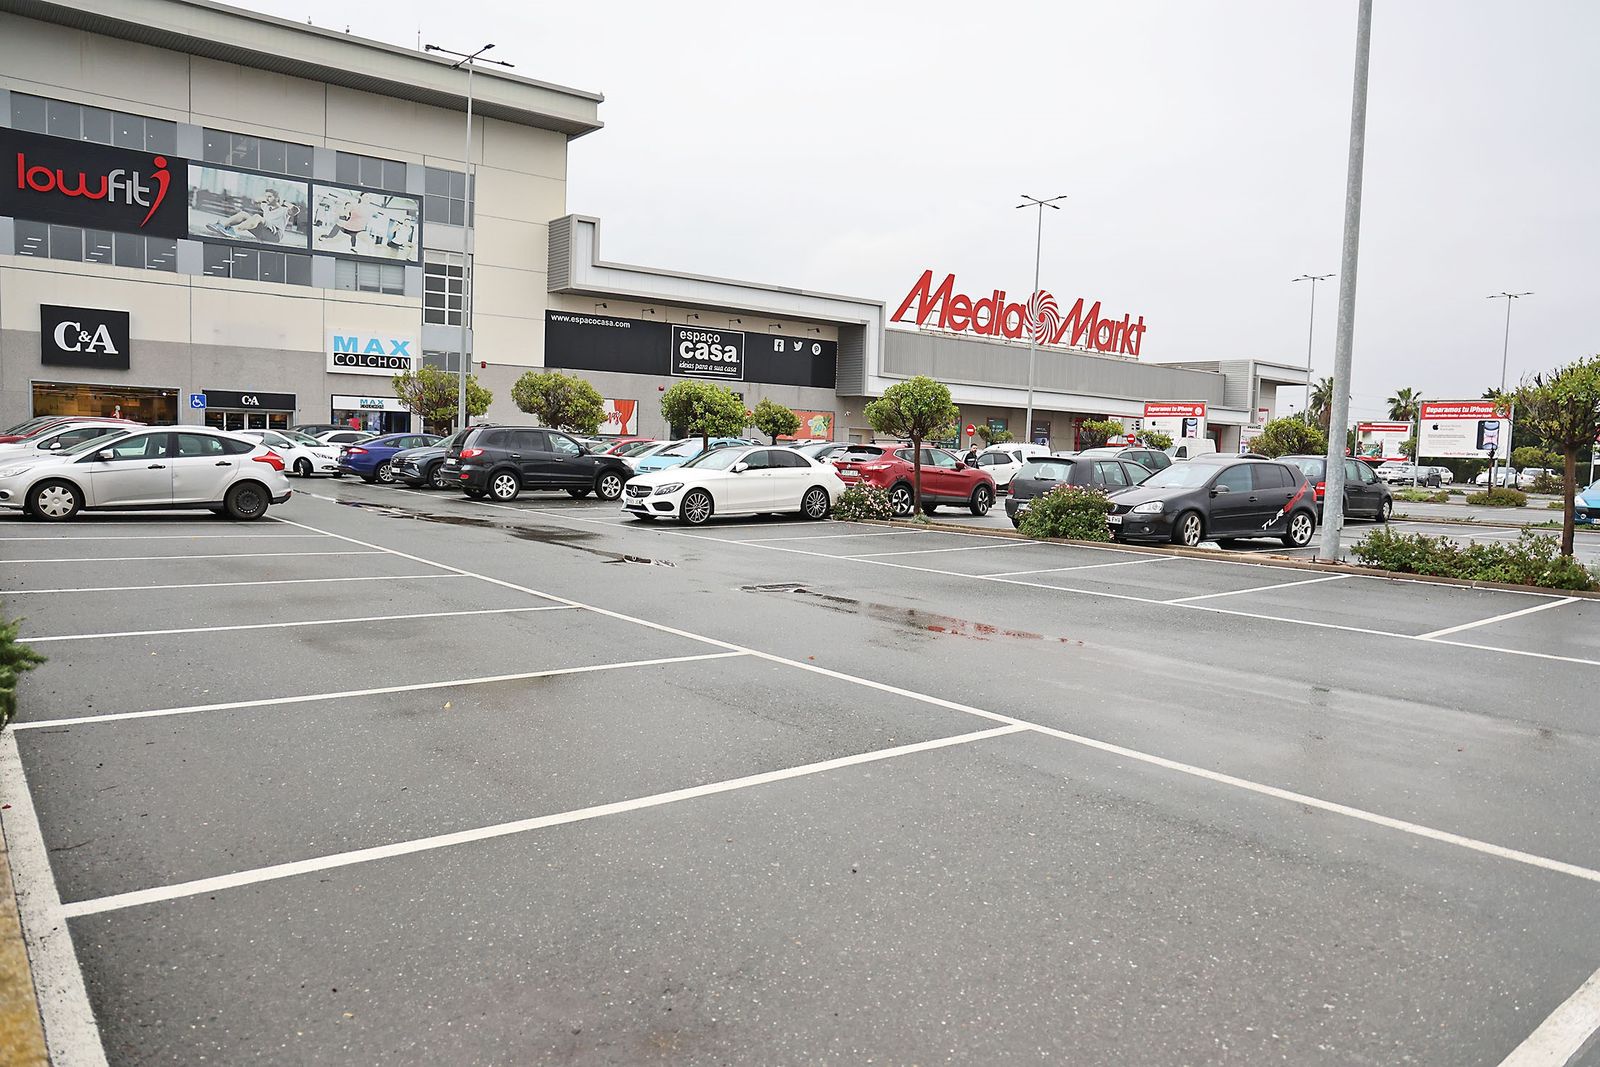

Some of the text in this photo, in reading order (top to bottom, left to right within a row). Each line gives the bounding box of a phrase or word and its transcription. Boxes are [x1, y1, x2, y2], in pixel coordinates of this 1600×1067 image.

[890, 269, 1147, 357] Media Markt
[550, 314, 631, 329] www.espacocasa.com
[53, 321, 119, 355] C&A
[679, 330, 721, 344] espaço
[333, 335, 411, 357] MAX
[334, 353, 411, 370] COLCHON
[678, 360, 695, 369] ideias
[695, 363, 709, 371] para
[1426, 406, 1461, 414] Reparamos
